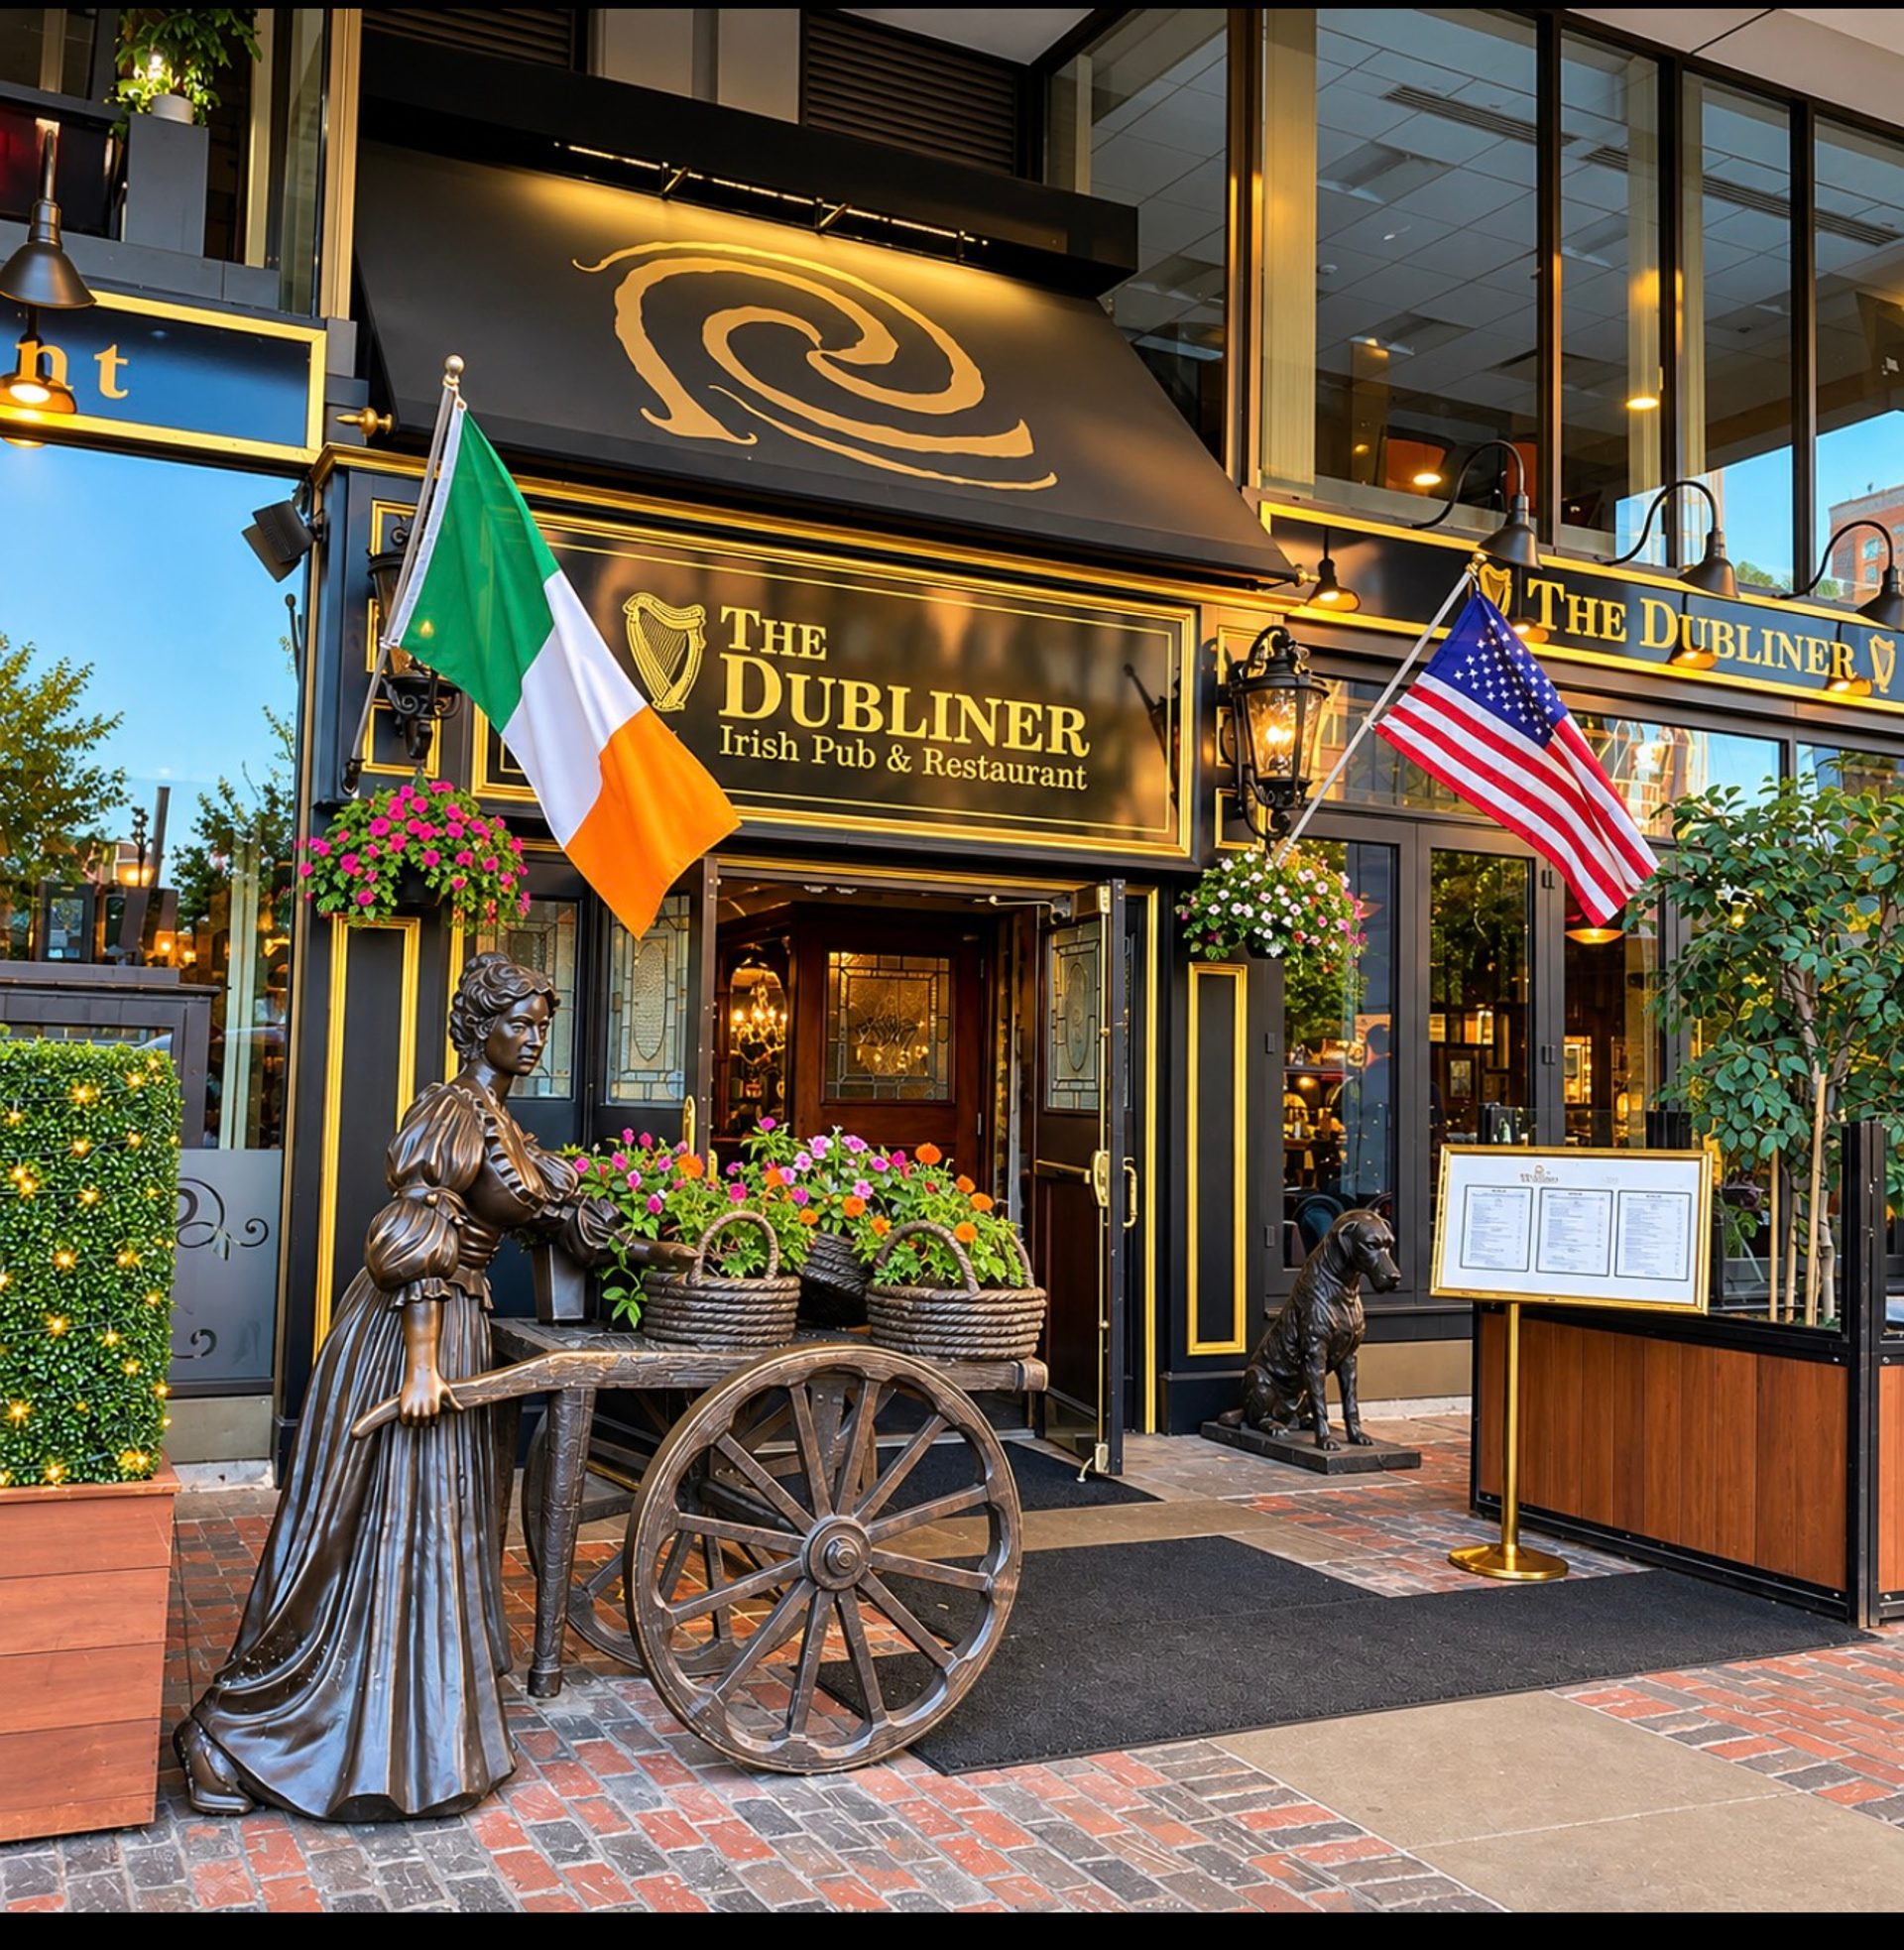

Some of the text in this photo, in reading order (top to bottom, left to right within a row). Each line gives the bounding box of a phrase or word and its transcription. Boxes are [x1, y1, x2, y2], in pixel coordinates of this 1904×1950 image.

[720, 605, 828, 662] THE
[1527, 577, 1857, 679] THE DUBLINER
[718, 653, 1090, 758] DUBLINER
[720, 725, 1088, 792] Irish Pub & Restaurant
